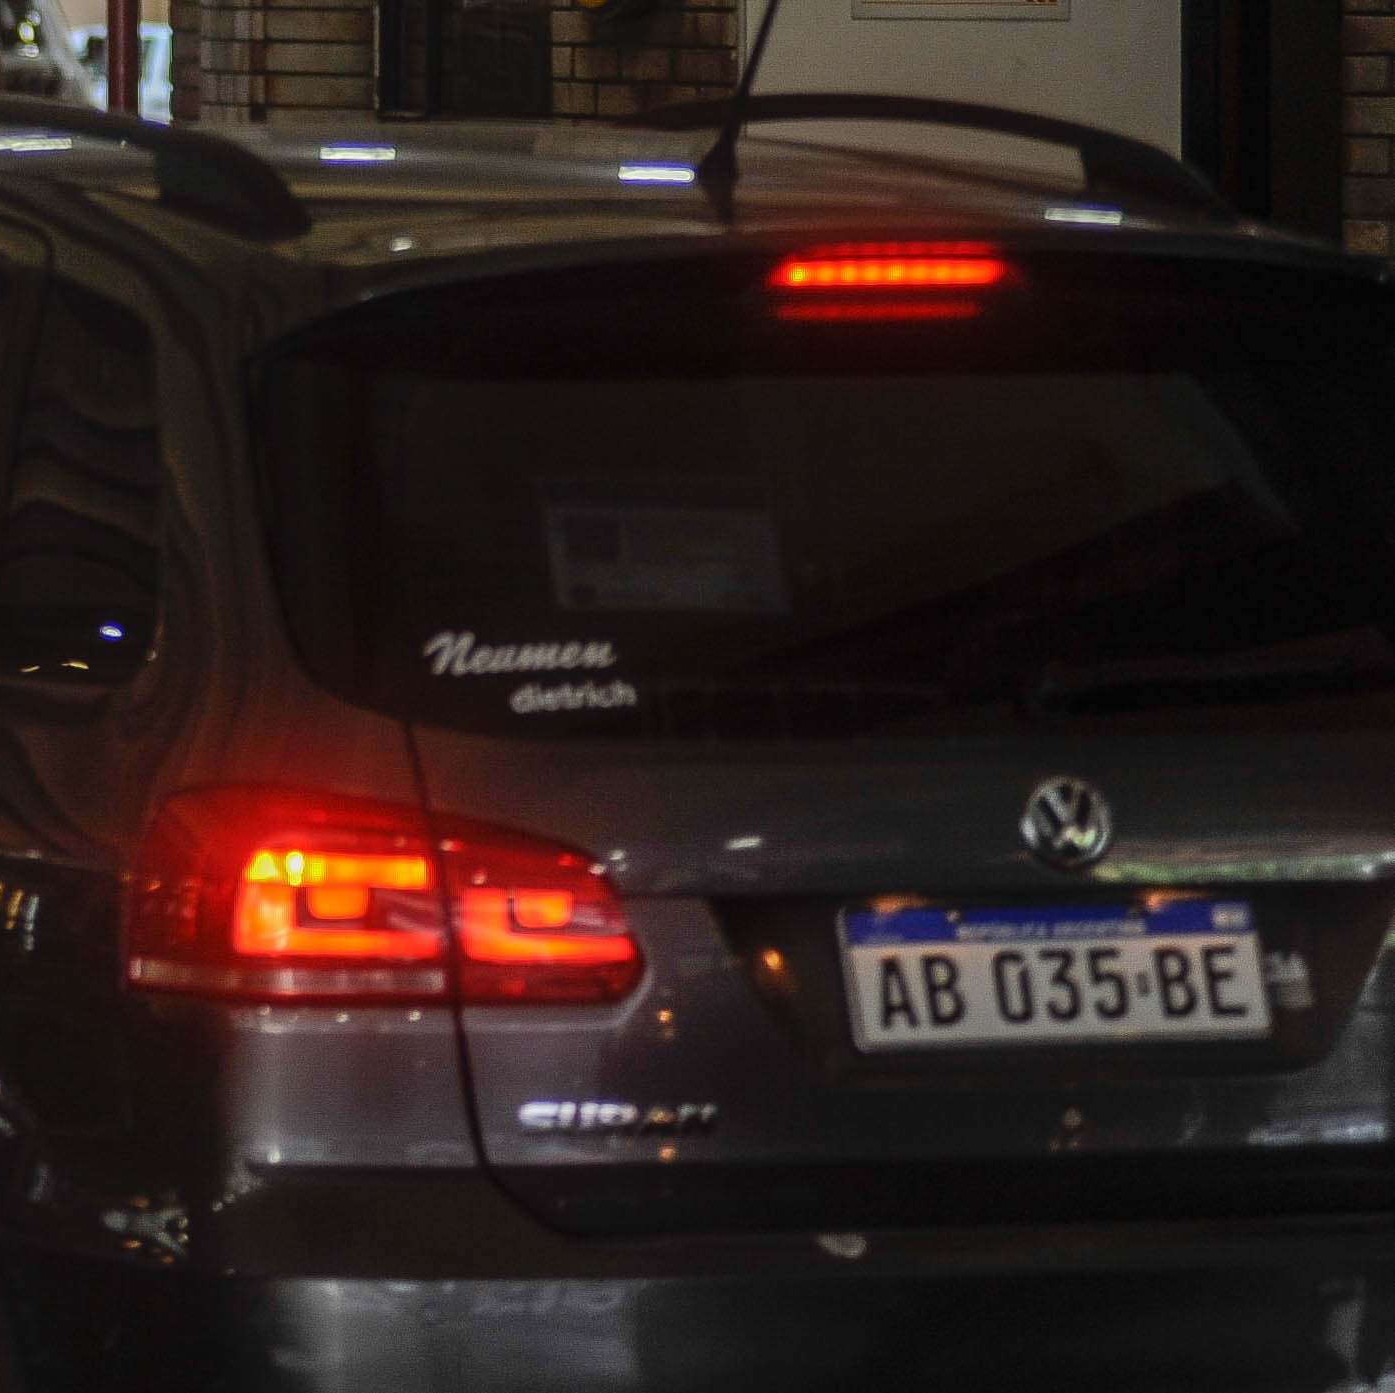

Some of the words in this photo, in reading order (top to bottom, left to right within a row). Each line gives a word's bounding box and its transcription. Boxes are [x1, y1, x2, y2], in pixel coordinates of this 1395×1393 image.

[879, 953, 967, 1029] AB
[992, 947, 1128, 1025] 035
[1153, 942, 1249, 1020] BE
